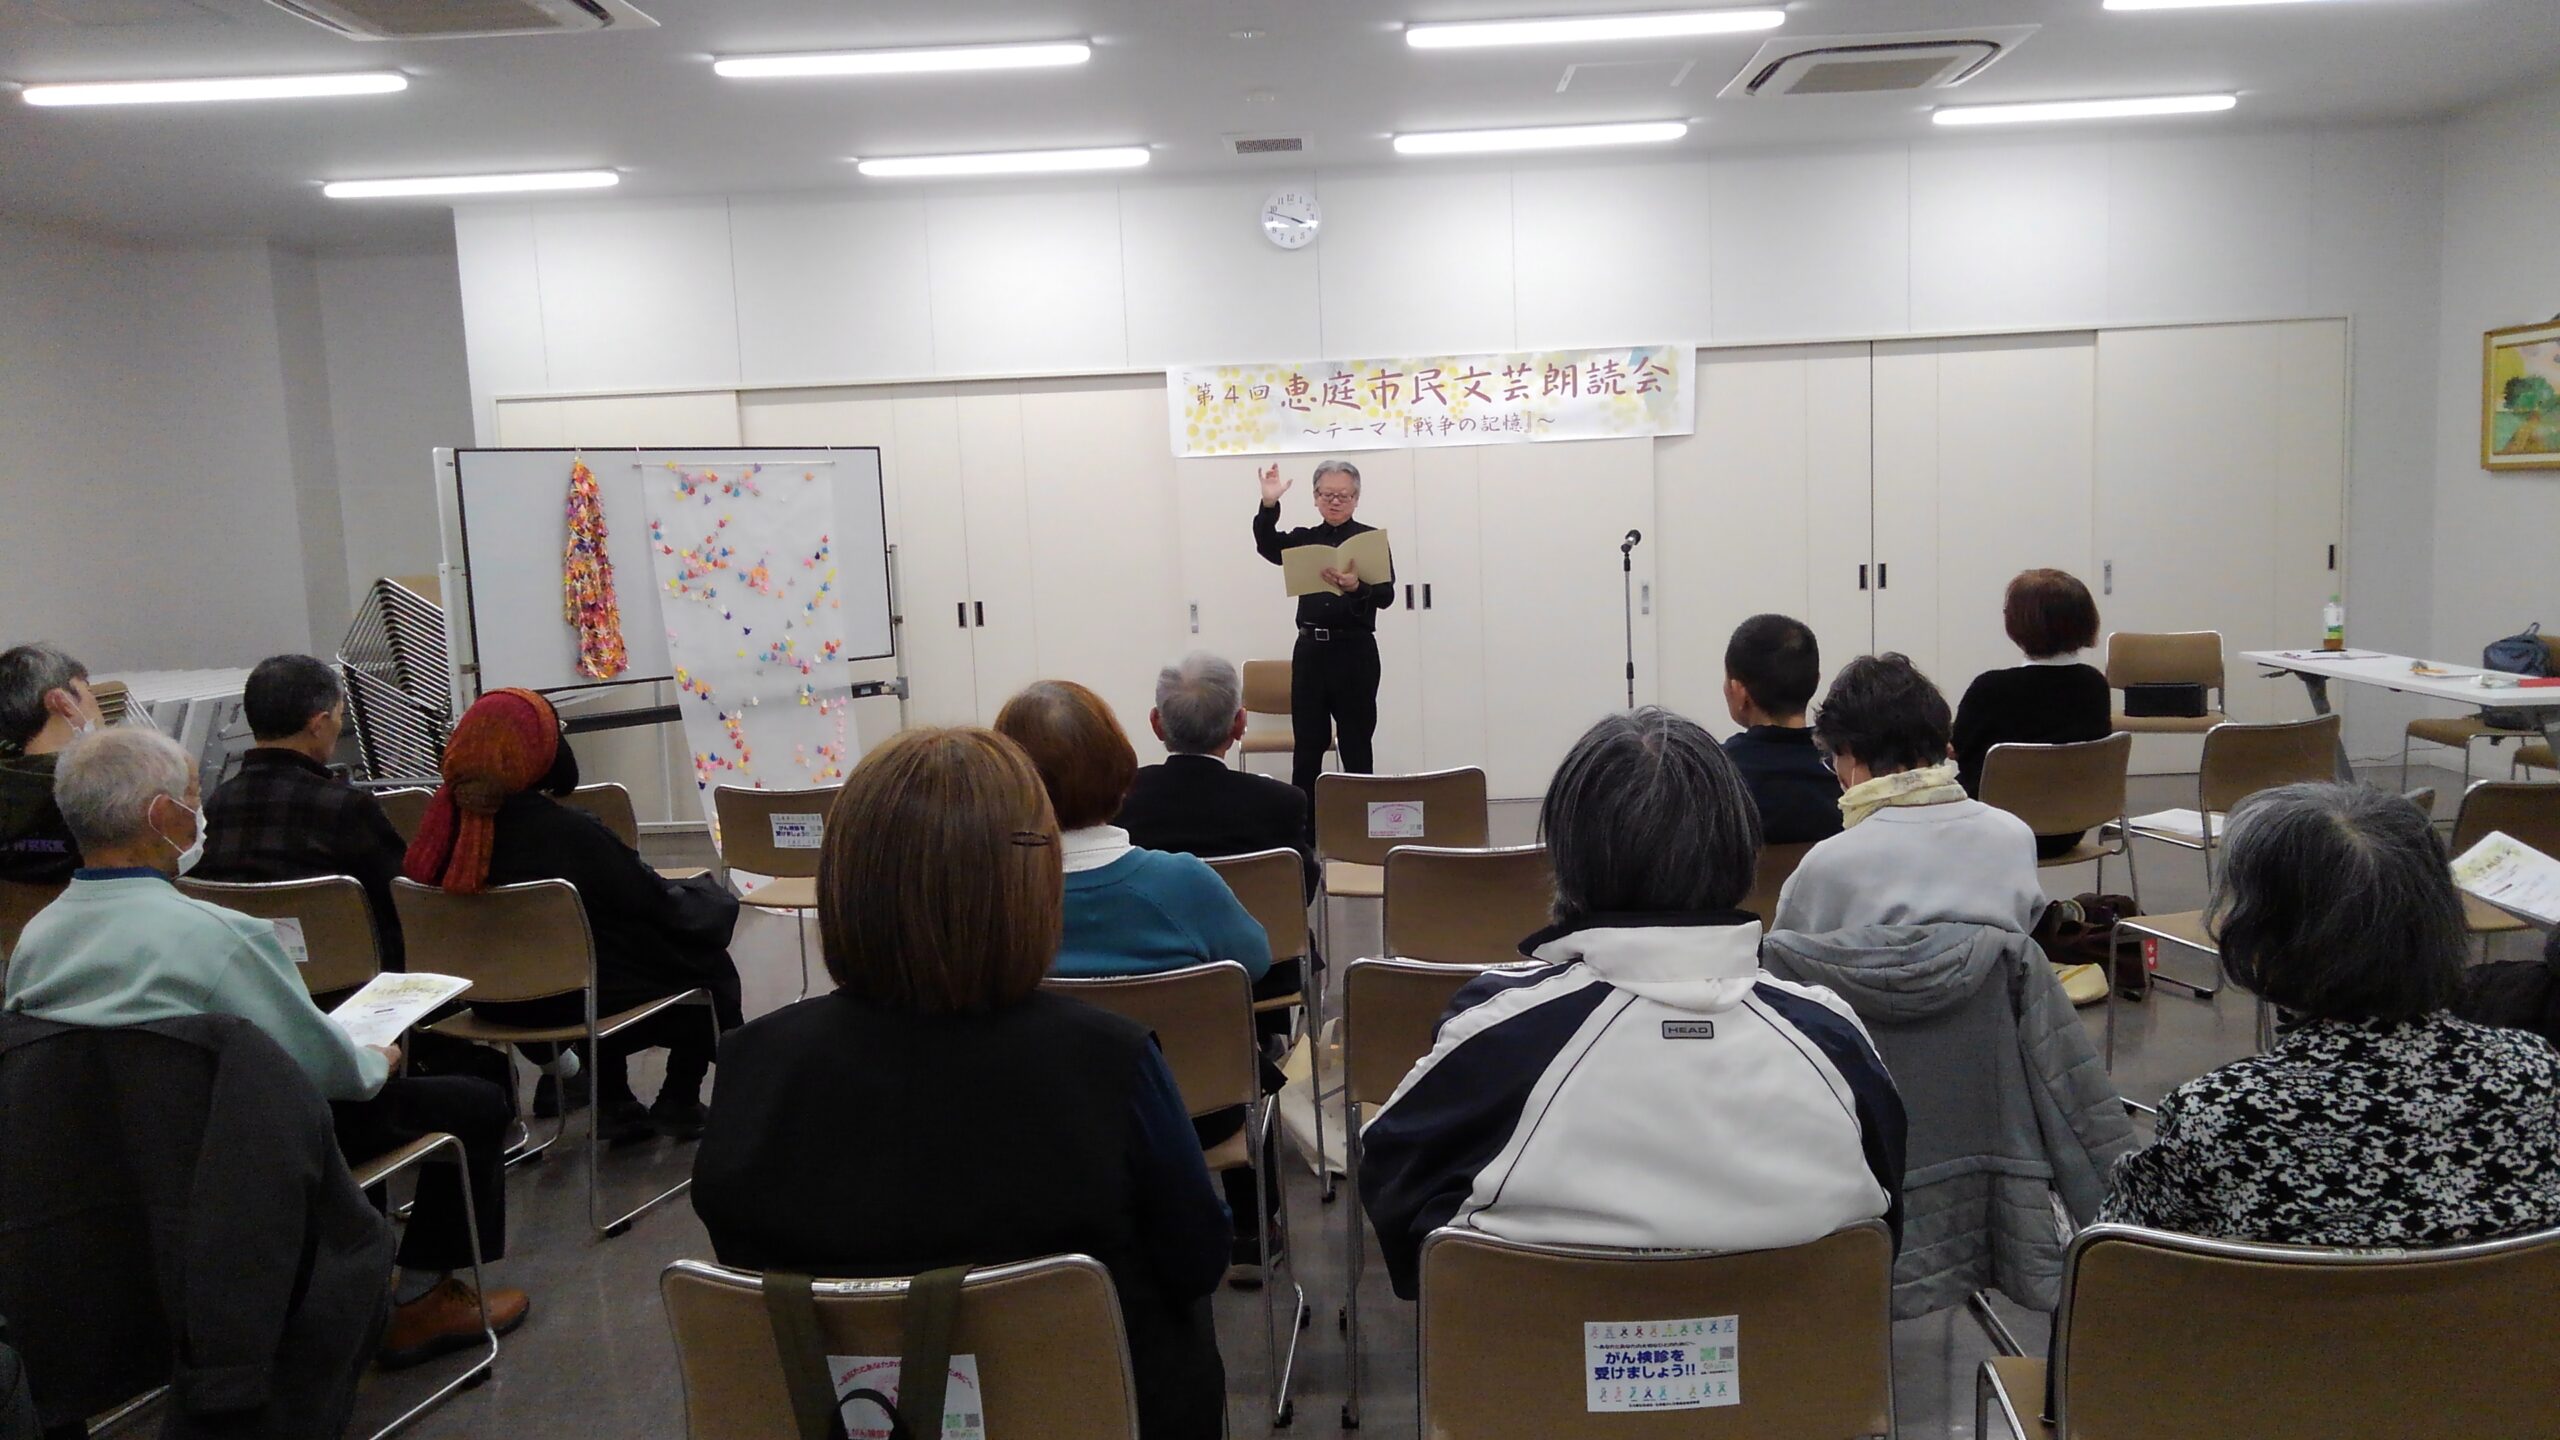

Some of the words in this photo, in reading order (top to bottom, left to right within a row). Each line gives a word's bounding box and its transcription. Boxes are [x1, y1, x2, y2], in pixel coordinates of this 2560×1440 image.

[1281, 356, 1670, 412] 恵庭市民文芸朗読会
[1605, 1350, 1685, 1364] がん検診を
